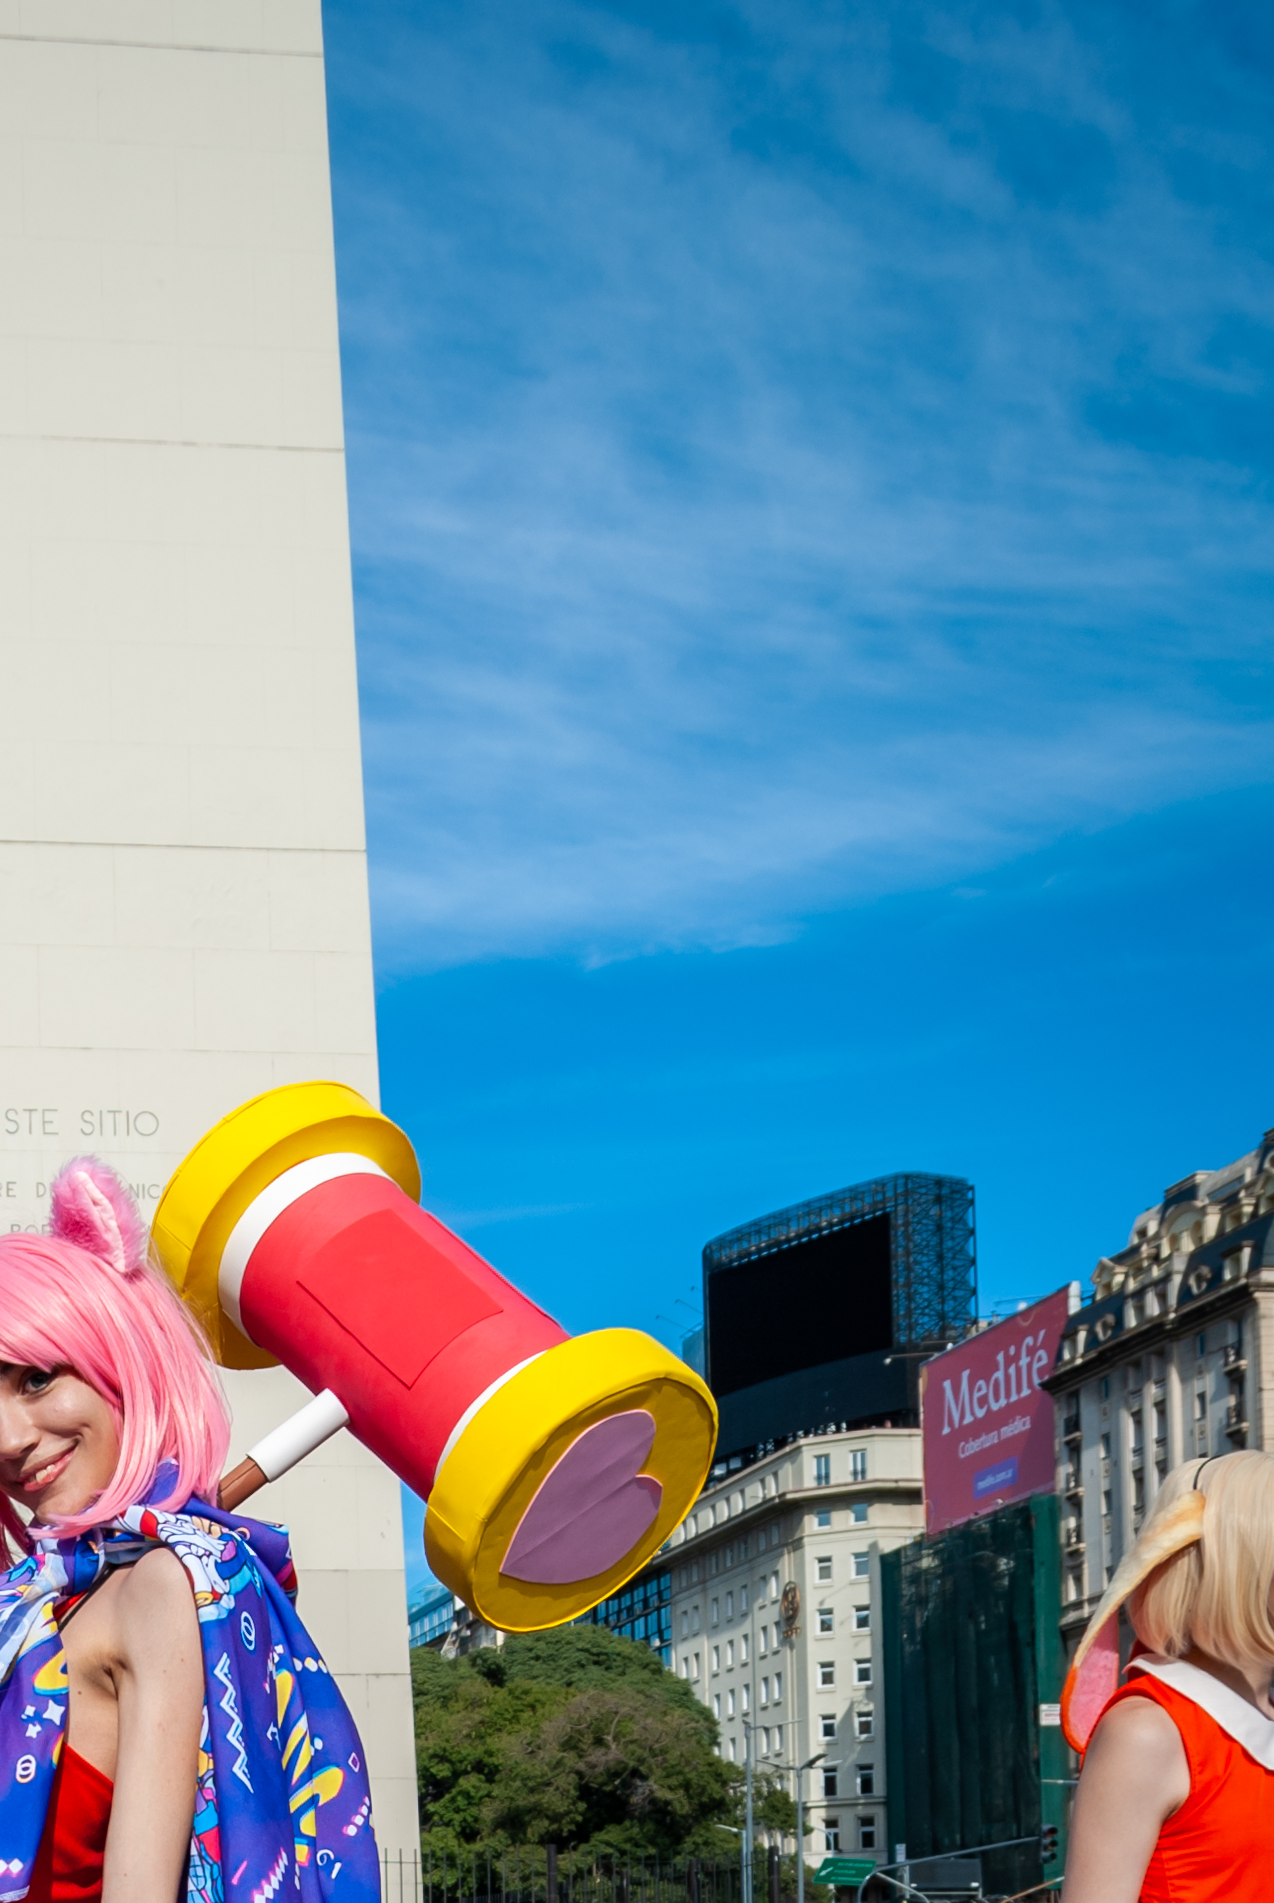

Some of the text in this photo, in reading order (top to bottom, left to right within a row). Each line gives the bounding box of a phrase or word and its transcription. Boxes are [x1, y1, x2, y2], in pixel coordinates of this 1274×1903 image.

[79, 1109, 160, 1137] SITIO
[128, 1183, 167, 1200] NIC
[942, 1329, 1050, 1436] Medifé
[958, 1415, 1031, 1459] Cobertura médica
